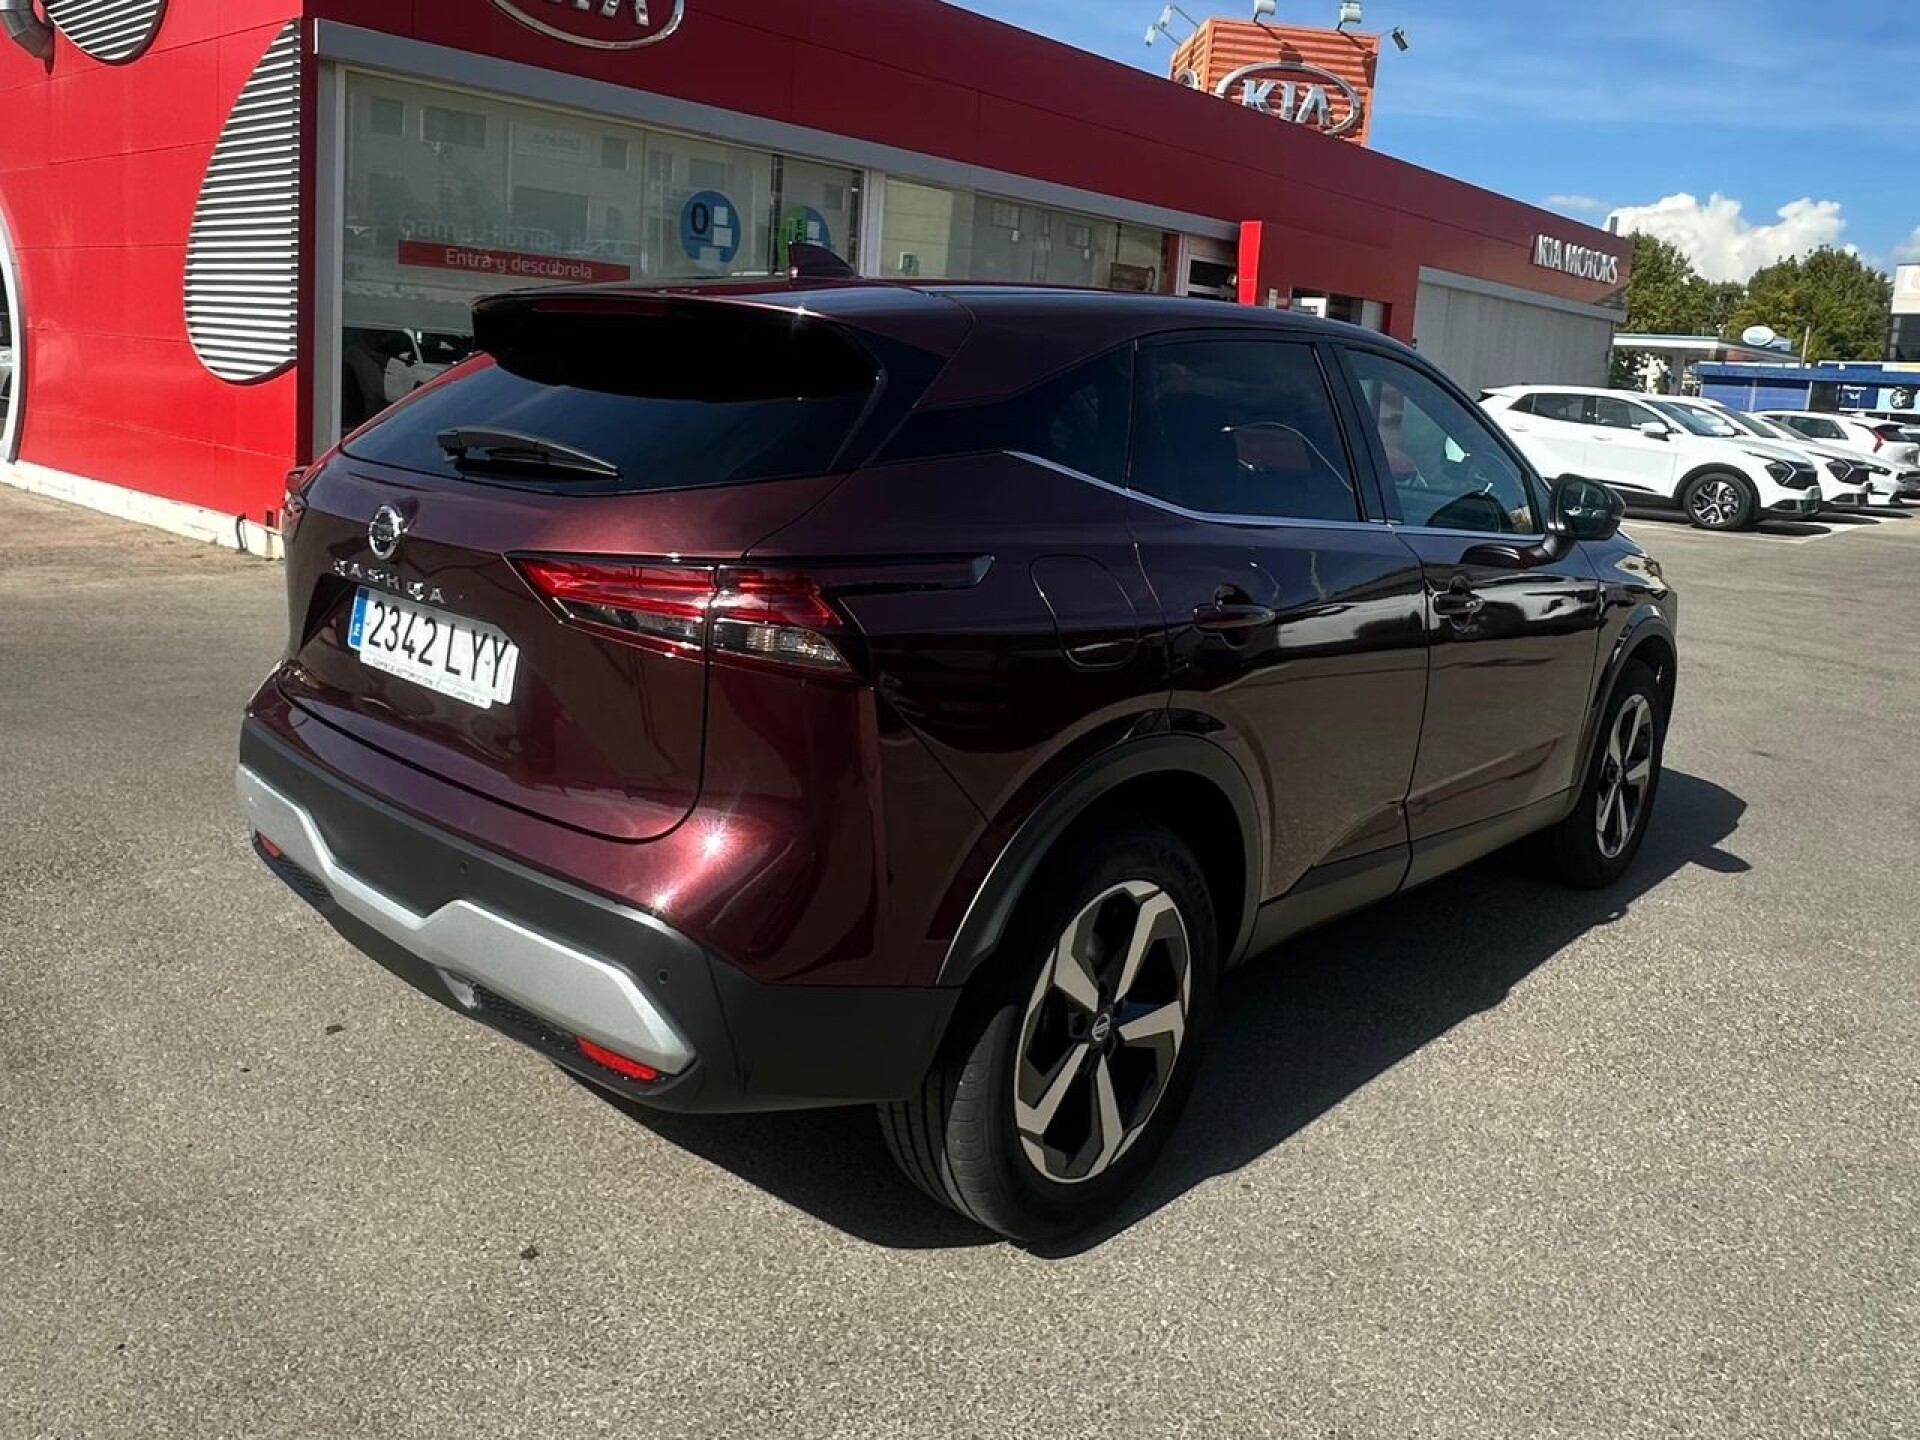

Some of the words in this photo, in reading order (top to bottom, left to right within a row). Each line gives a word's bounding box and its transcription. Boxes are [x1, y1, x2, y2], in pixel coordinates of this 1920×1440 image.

[1241, 78, 1331, 126] KIA
[445, 247, 492, 268] Entra
[496, 257, 507, 272] y
[1535, 235, 1562, 271] KIA
[1565, 243, 1618, 284] MOTORS
[368, 602, 437, 667] 2342
[445, 623, 510, 688] LYY
